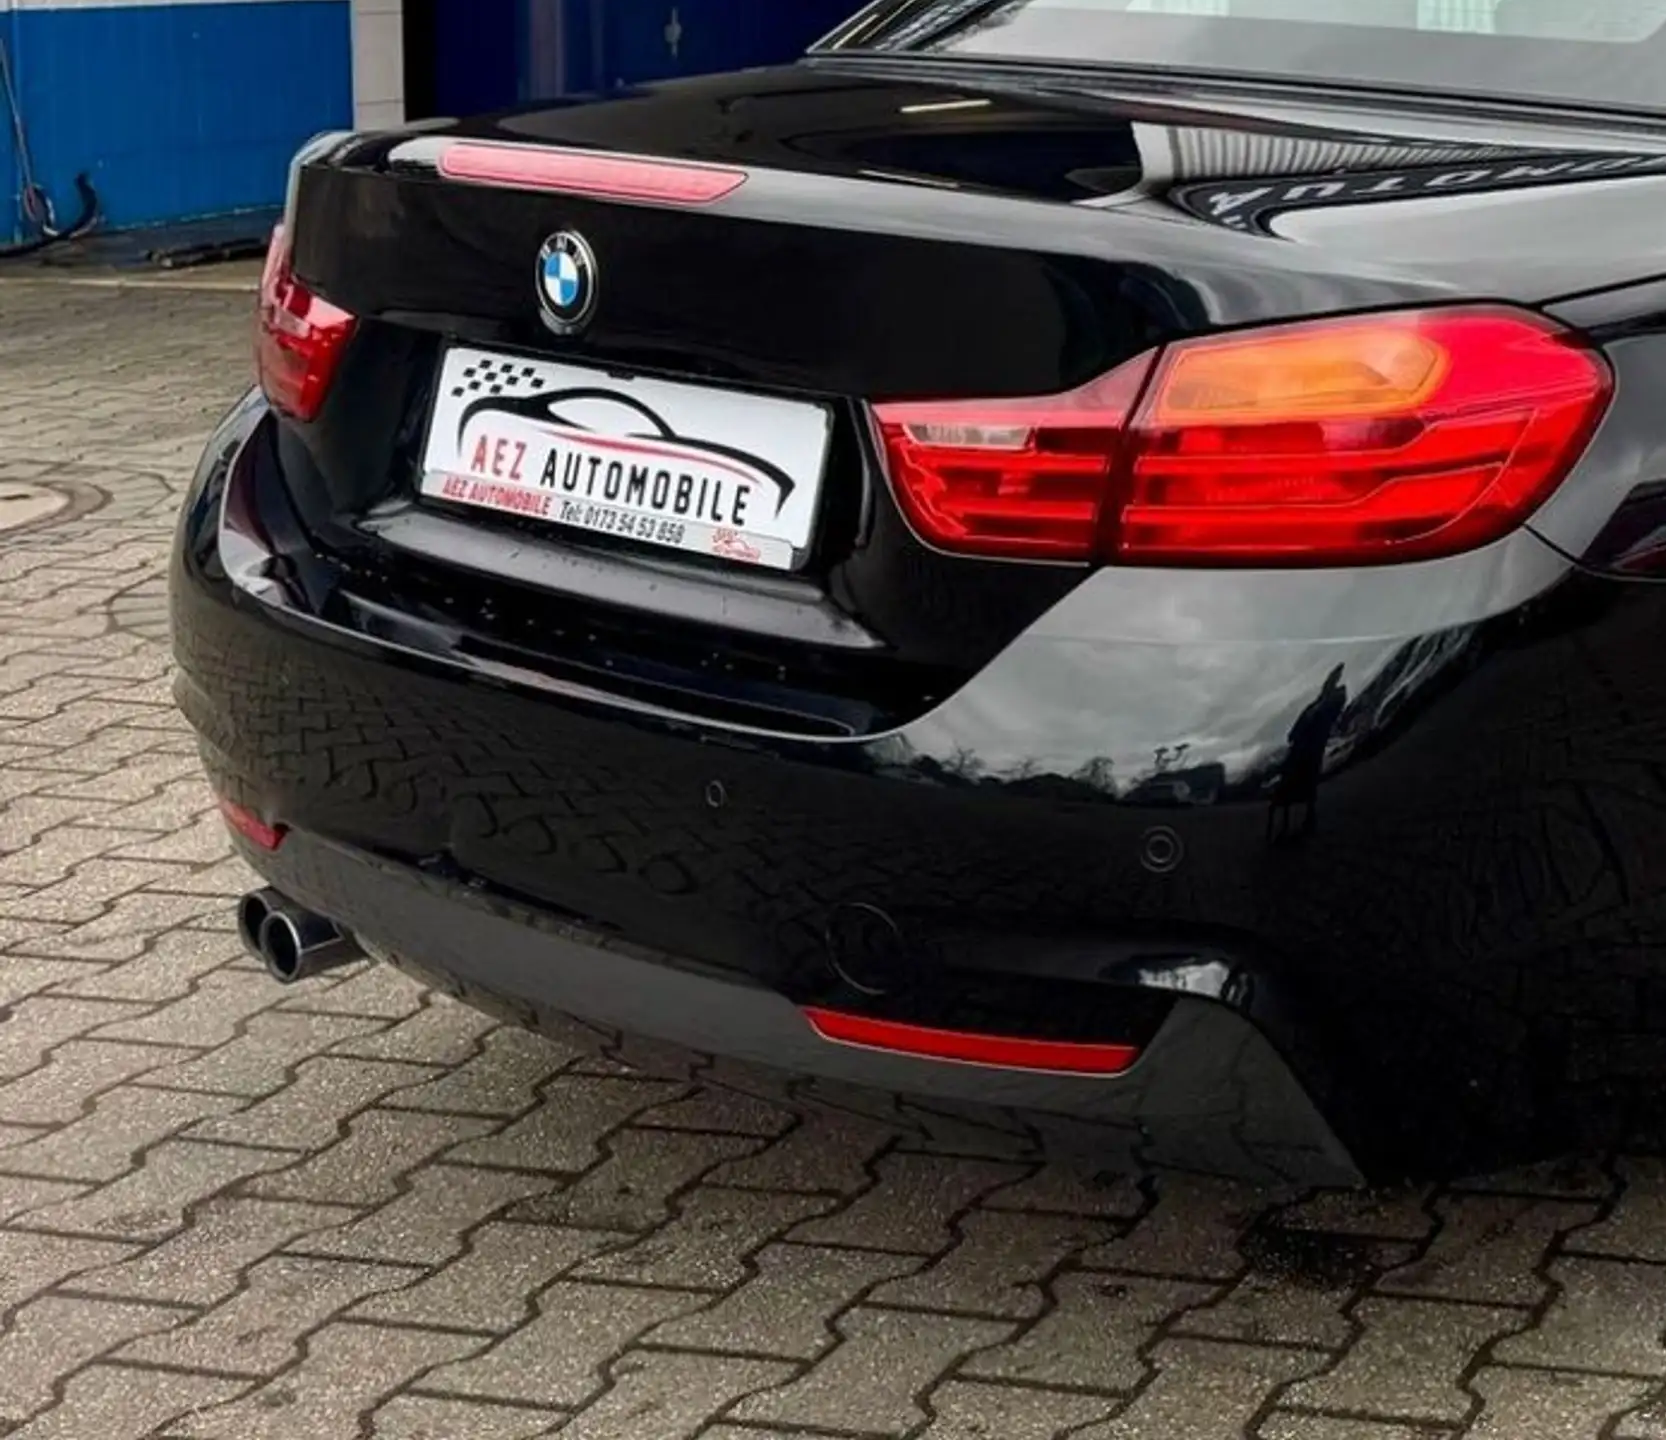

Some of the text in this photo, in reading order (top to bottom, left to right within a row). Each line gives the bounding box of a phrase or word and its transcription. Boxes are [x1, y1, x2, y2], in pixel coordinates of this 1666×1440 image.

[442, 475, 468, 499] AEZ
[469, 481, 552, 517] AUTOMOBILE
[471, 433, 752, 527] AEZ AUTOMOBILE
